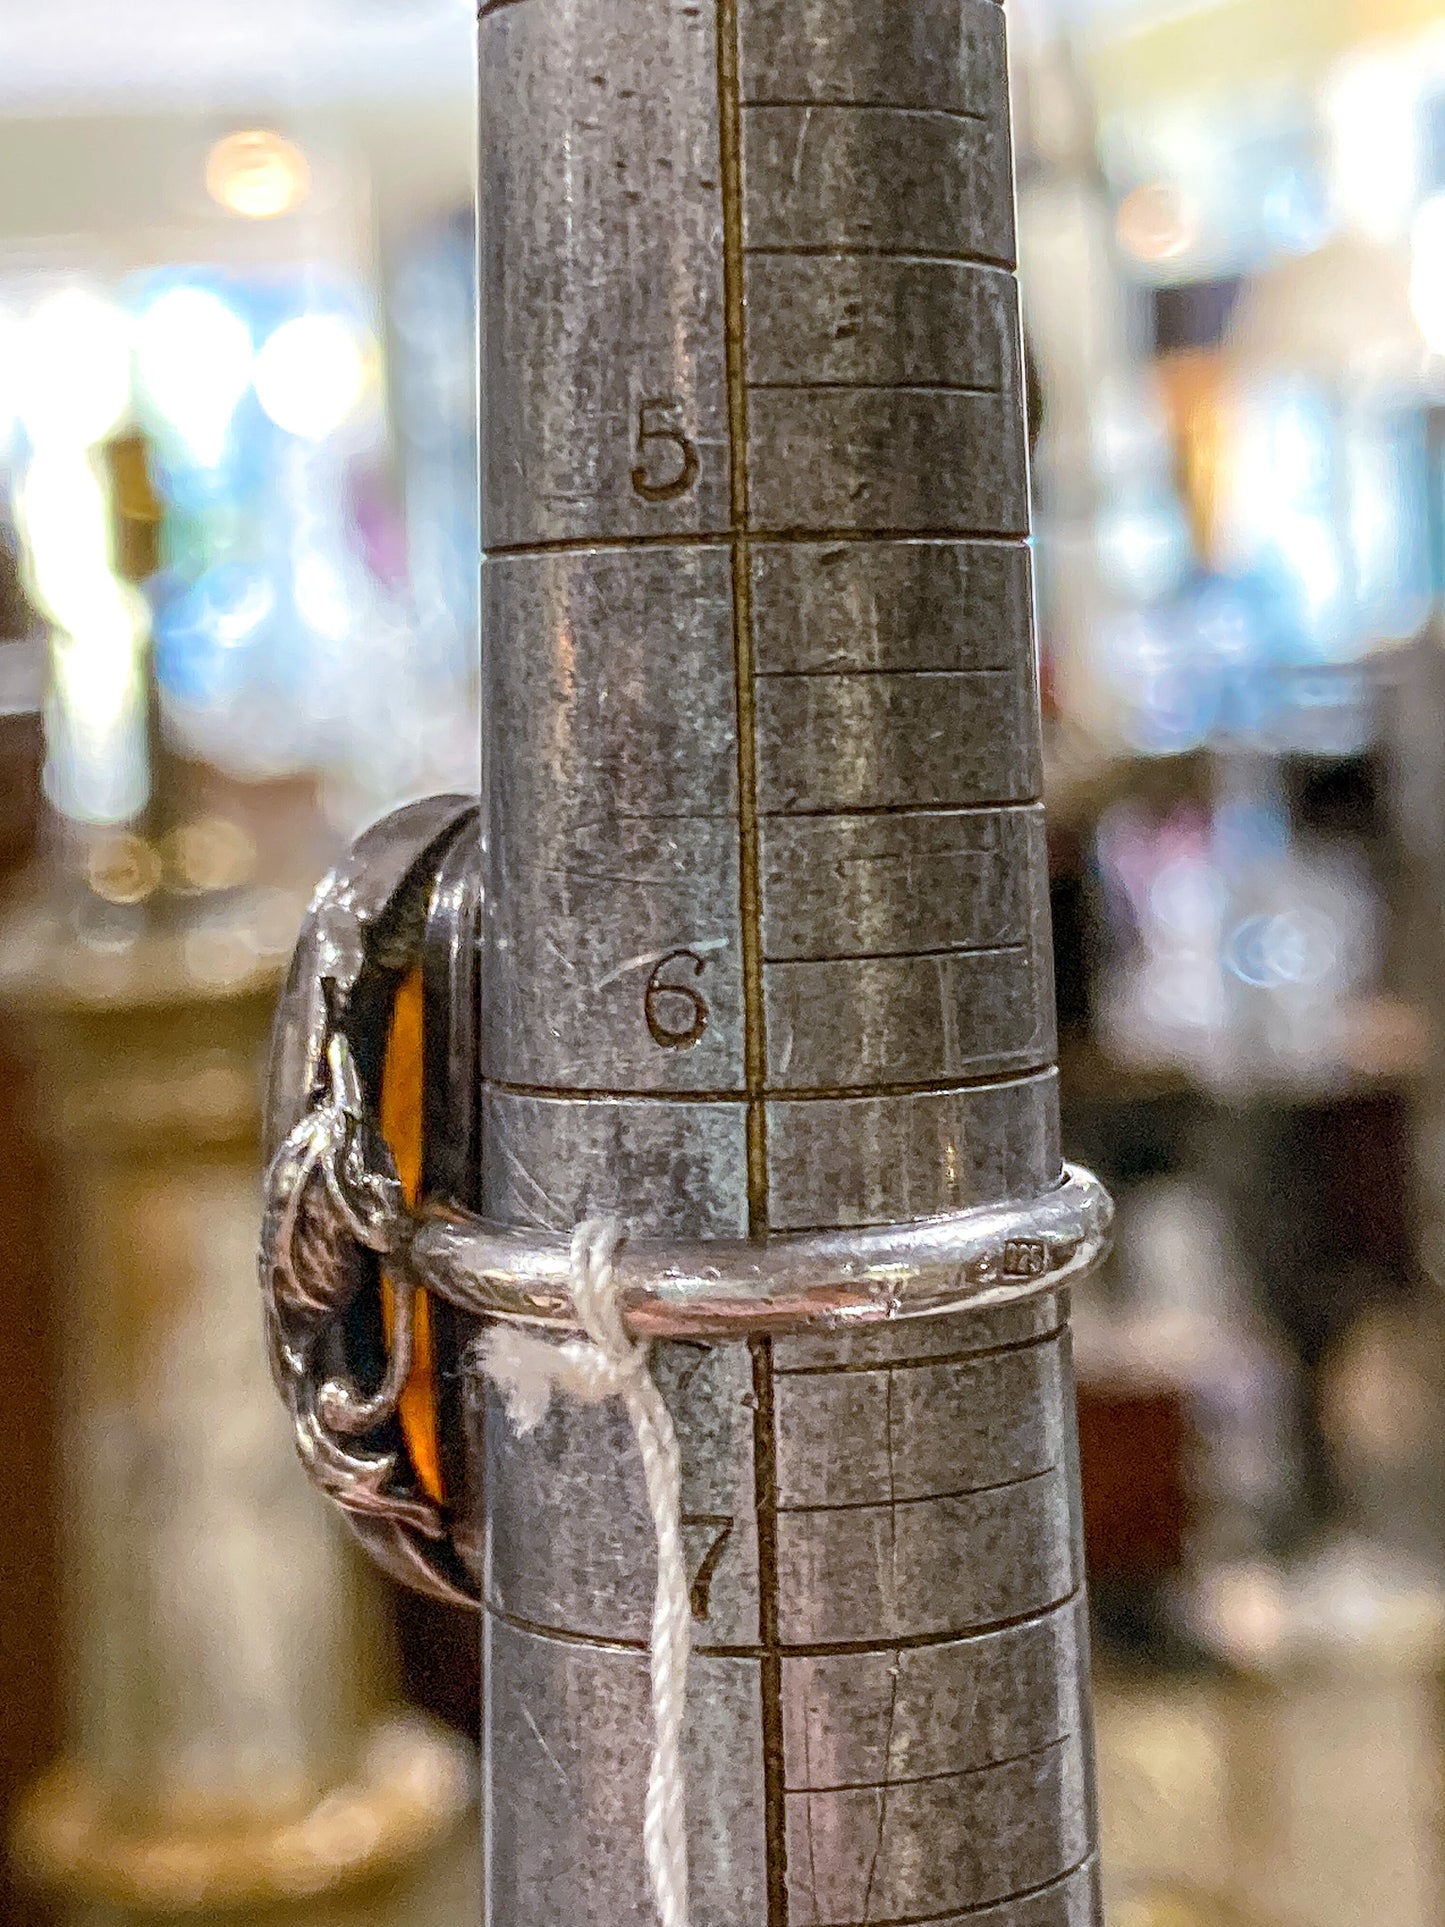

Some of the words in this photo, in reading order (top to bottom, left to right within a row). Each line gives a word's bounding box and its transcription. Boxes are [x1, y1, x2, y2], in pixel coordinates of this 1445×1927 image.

[632, 399, 699, 502] 5
[644, 948, 710, 1052] 6
[680, 1514, 734, 1621] 7
